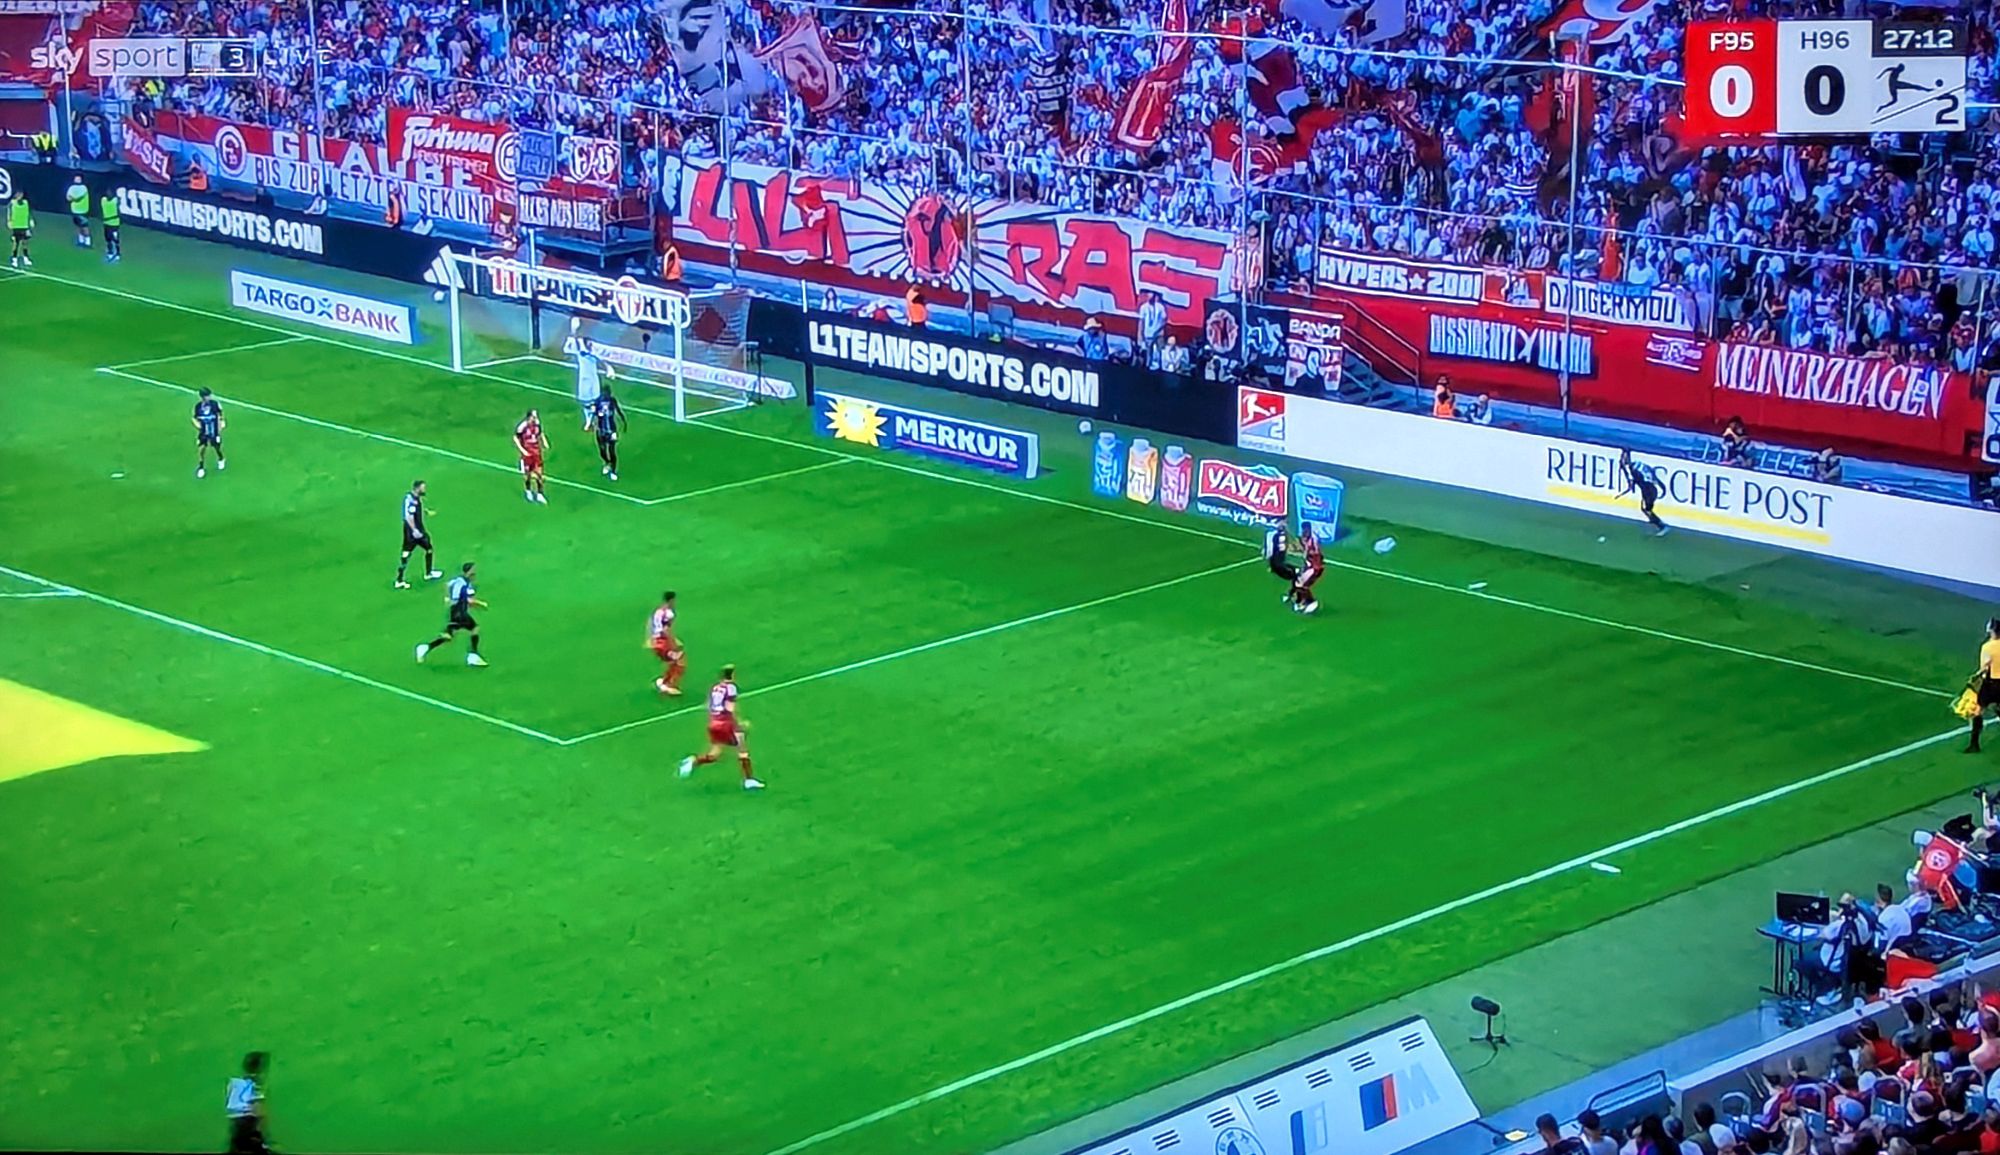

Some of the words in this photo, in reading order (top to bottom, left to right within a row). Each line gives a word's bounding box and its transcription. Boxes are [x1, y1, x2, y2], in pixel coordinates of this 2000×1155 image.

[402, 116, 496, 162] Fortuna
[255, 156, 281, 187] BIS
[116, 187, 324, 255] 11TEAMSPORTS.COM
[1713, 341, 1951, 421] MEINERZHAGEN
[895, 415, 1019, 462] MERKUR
[1207, 466, 1280, 509] YAYLA
[1547, 446, 1731, 511] RHEINSCHE
[1742, 480, 1834, 529] POST
